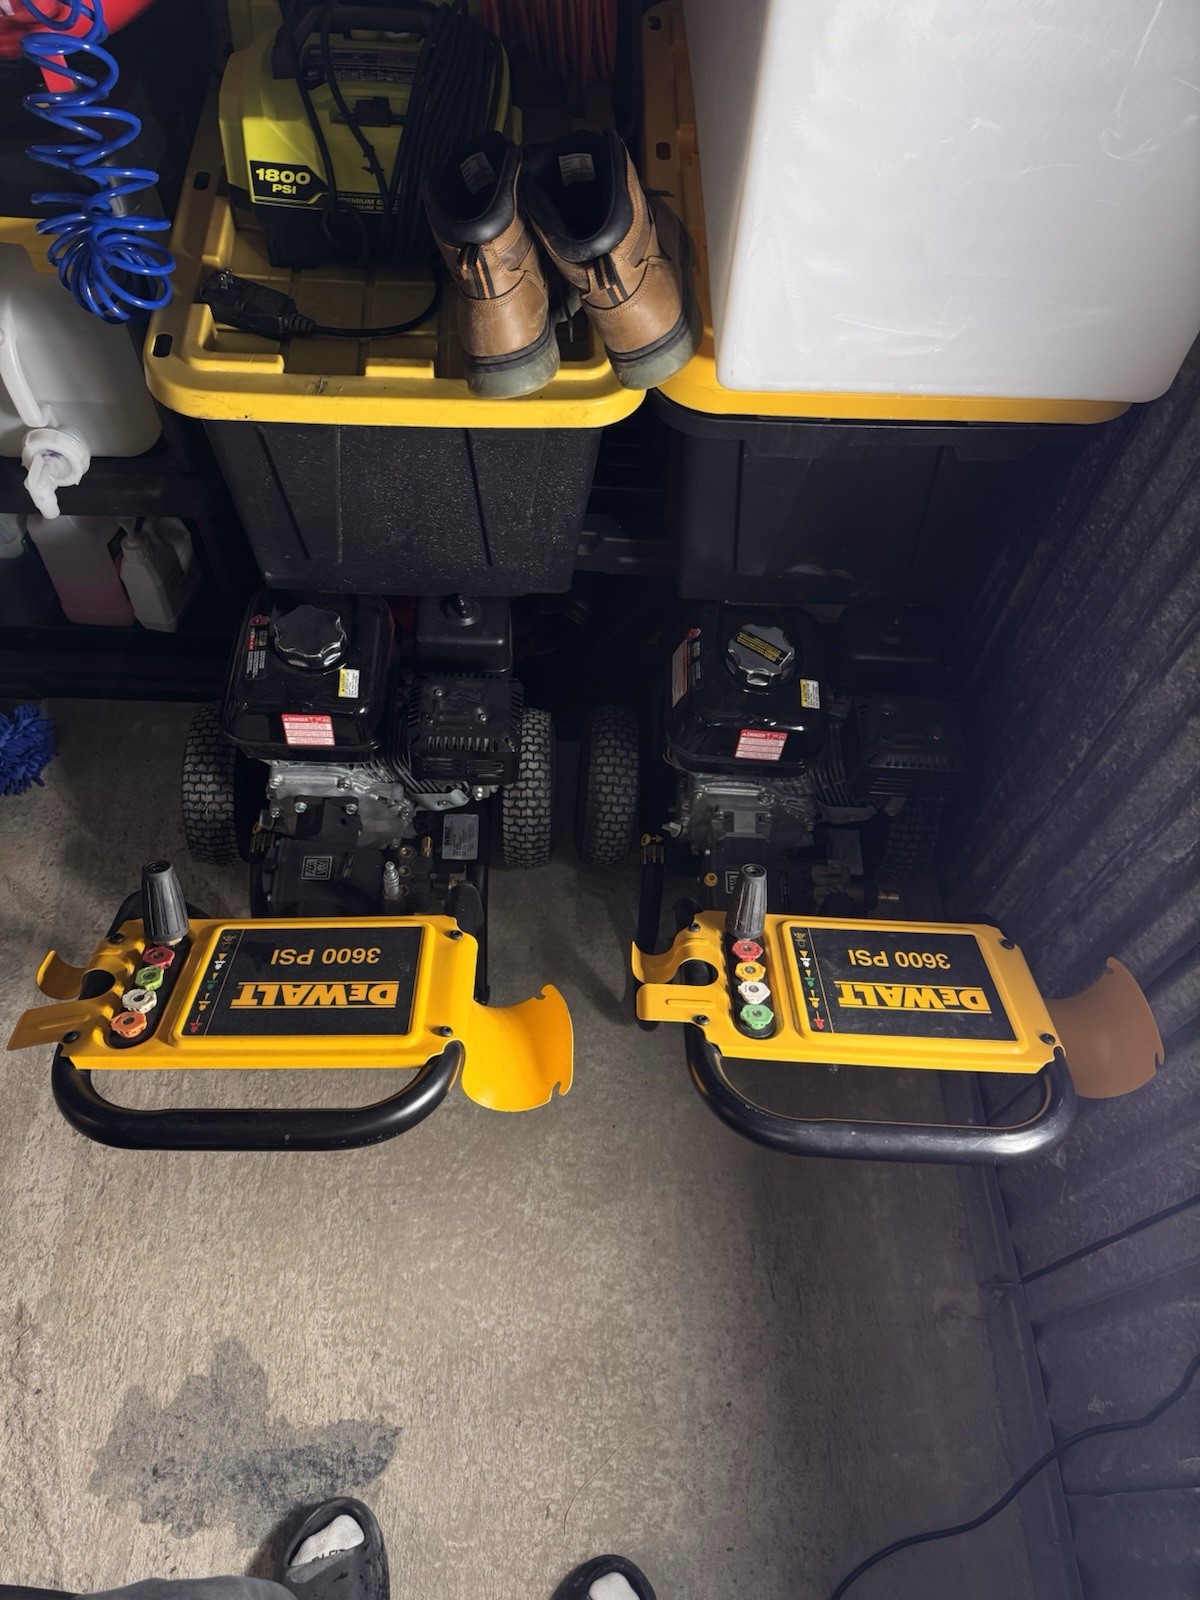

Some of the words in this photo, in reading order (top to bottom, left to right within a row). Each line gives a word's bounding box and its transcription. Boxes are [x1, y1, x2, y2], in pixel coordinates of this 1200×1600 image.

[255, 167, 311, 185] 1800
[271, 183, 297, 195] PSI
[270, 948, 315, 966] PSI
[322, 947, 381, 964] 3600
[848, 949, 889, 968] PSI
[895, 951, 951, 970] 3600
[231, 982, 399, 1007] DEWALT
[836, 983, 990, 1011] DEWALT
